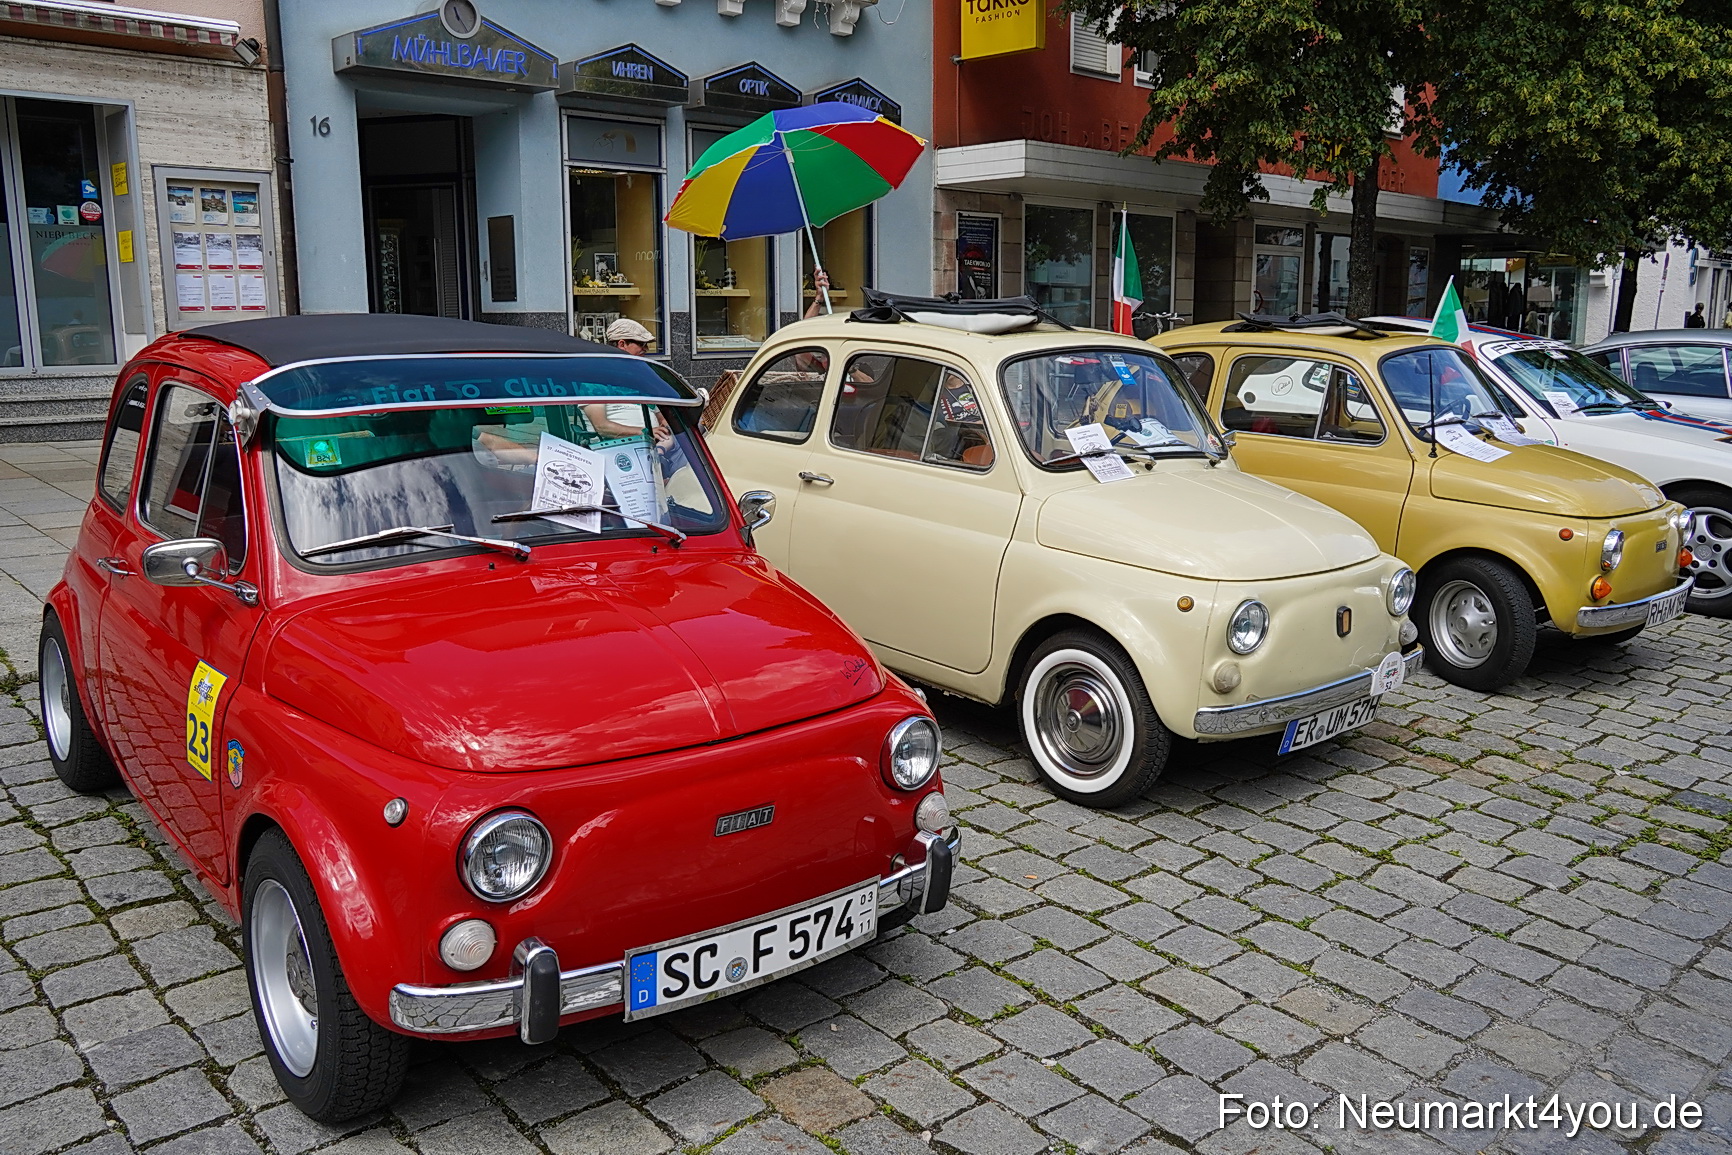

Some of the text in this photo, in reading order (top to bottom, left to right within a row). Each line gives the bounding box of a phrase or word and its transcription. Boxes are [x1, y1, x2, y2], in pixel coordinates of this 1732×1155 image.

[976, 9, 1020, 24] FASHION
[391, 34, 528, 76] MÜHLBAUER
[611, 60, 653, 82] UHREN
[739, 78, 770, 97] OPTIK
[834, 92, 883, 112] SCHMUCK
[310, 114, 330, 138] 16
[963, 259, 991, 268] TAEKWONDO
[371, 384, 436, 404] Fiat
[504, 376, 567, 397] Club
[188, 712, 209, 764] 23
[1291, 714, 1319, 748] ER
[1325, 705, 1350, 736] UM
[720, 807, 775, 834] FIAT
[860, 890, 874, 906] 03
[859, 918, 871, 934] 11
[638, 898, 854, 1004] D SC F 574
